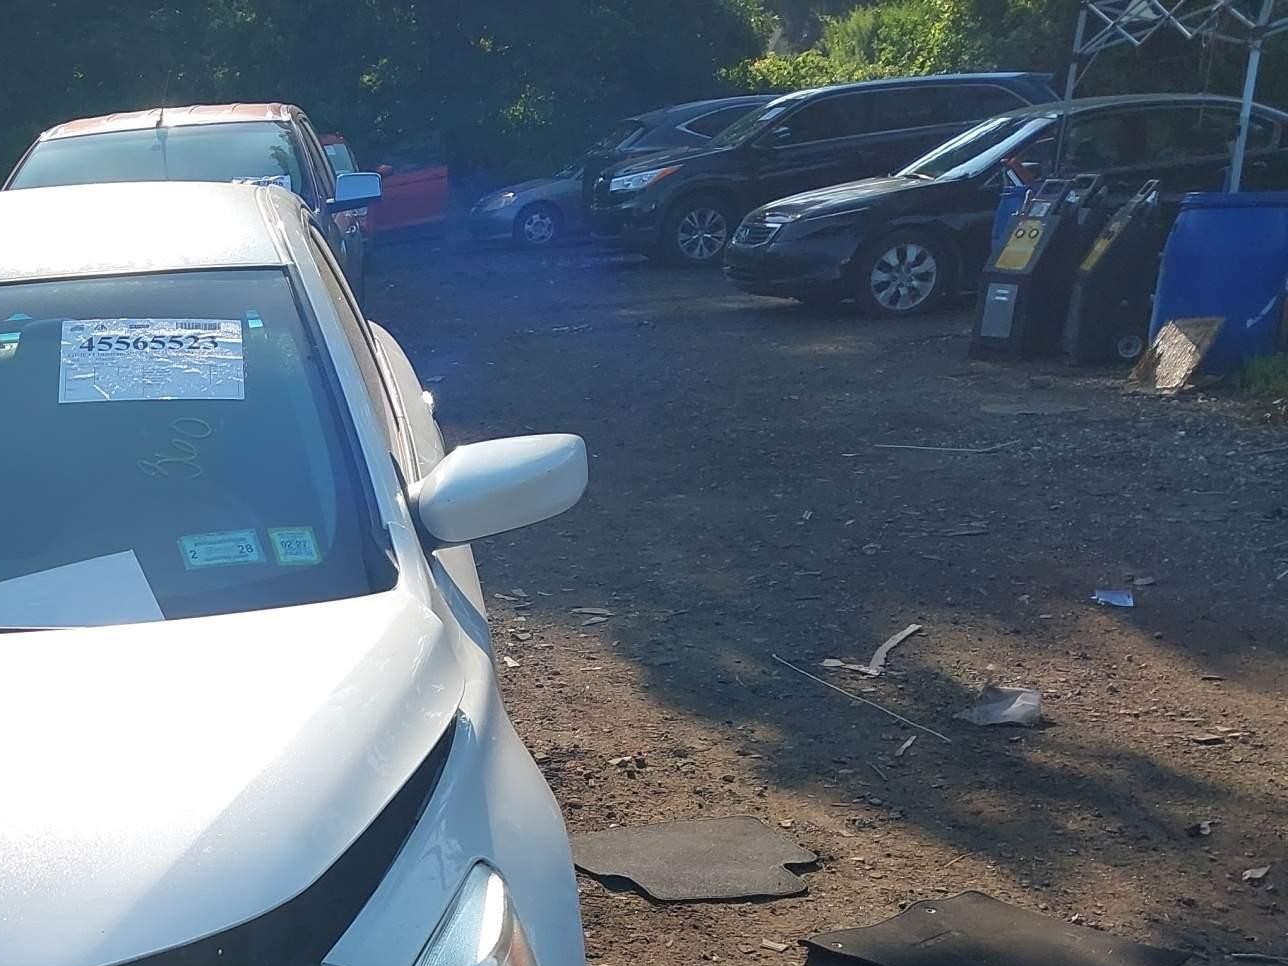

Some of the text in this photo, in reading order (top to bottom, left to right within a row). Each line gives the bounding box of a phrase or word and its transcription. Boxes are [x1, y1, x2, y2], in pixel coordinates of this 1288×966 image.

[79, 334, 219, 352] 45565523
[189, 550, 199, 559] 2
[237, 543, 254, 554] 28
